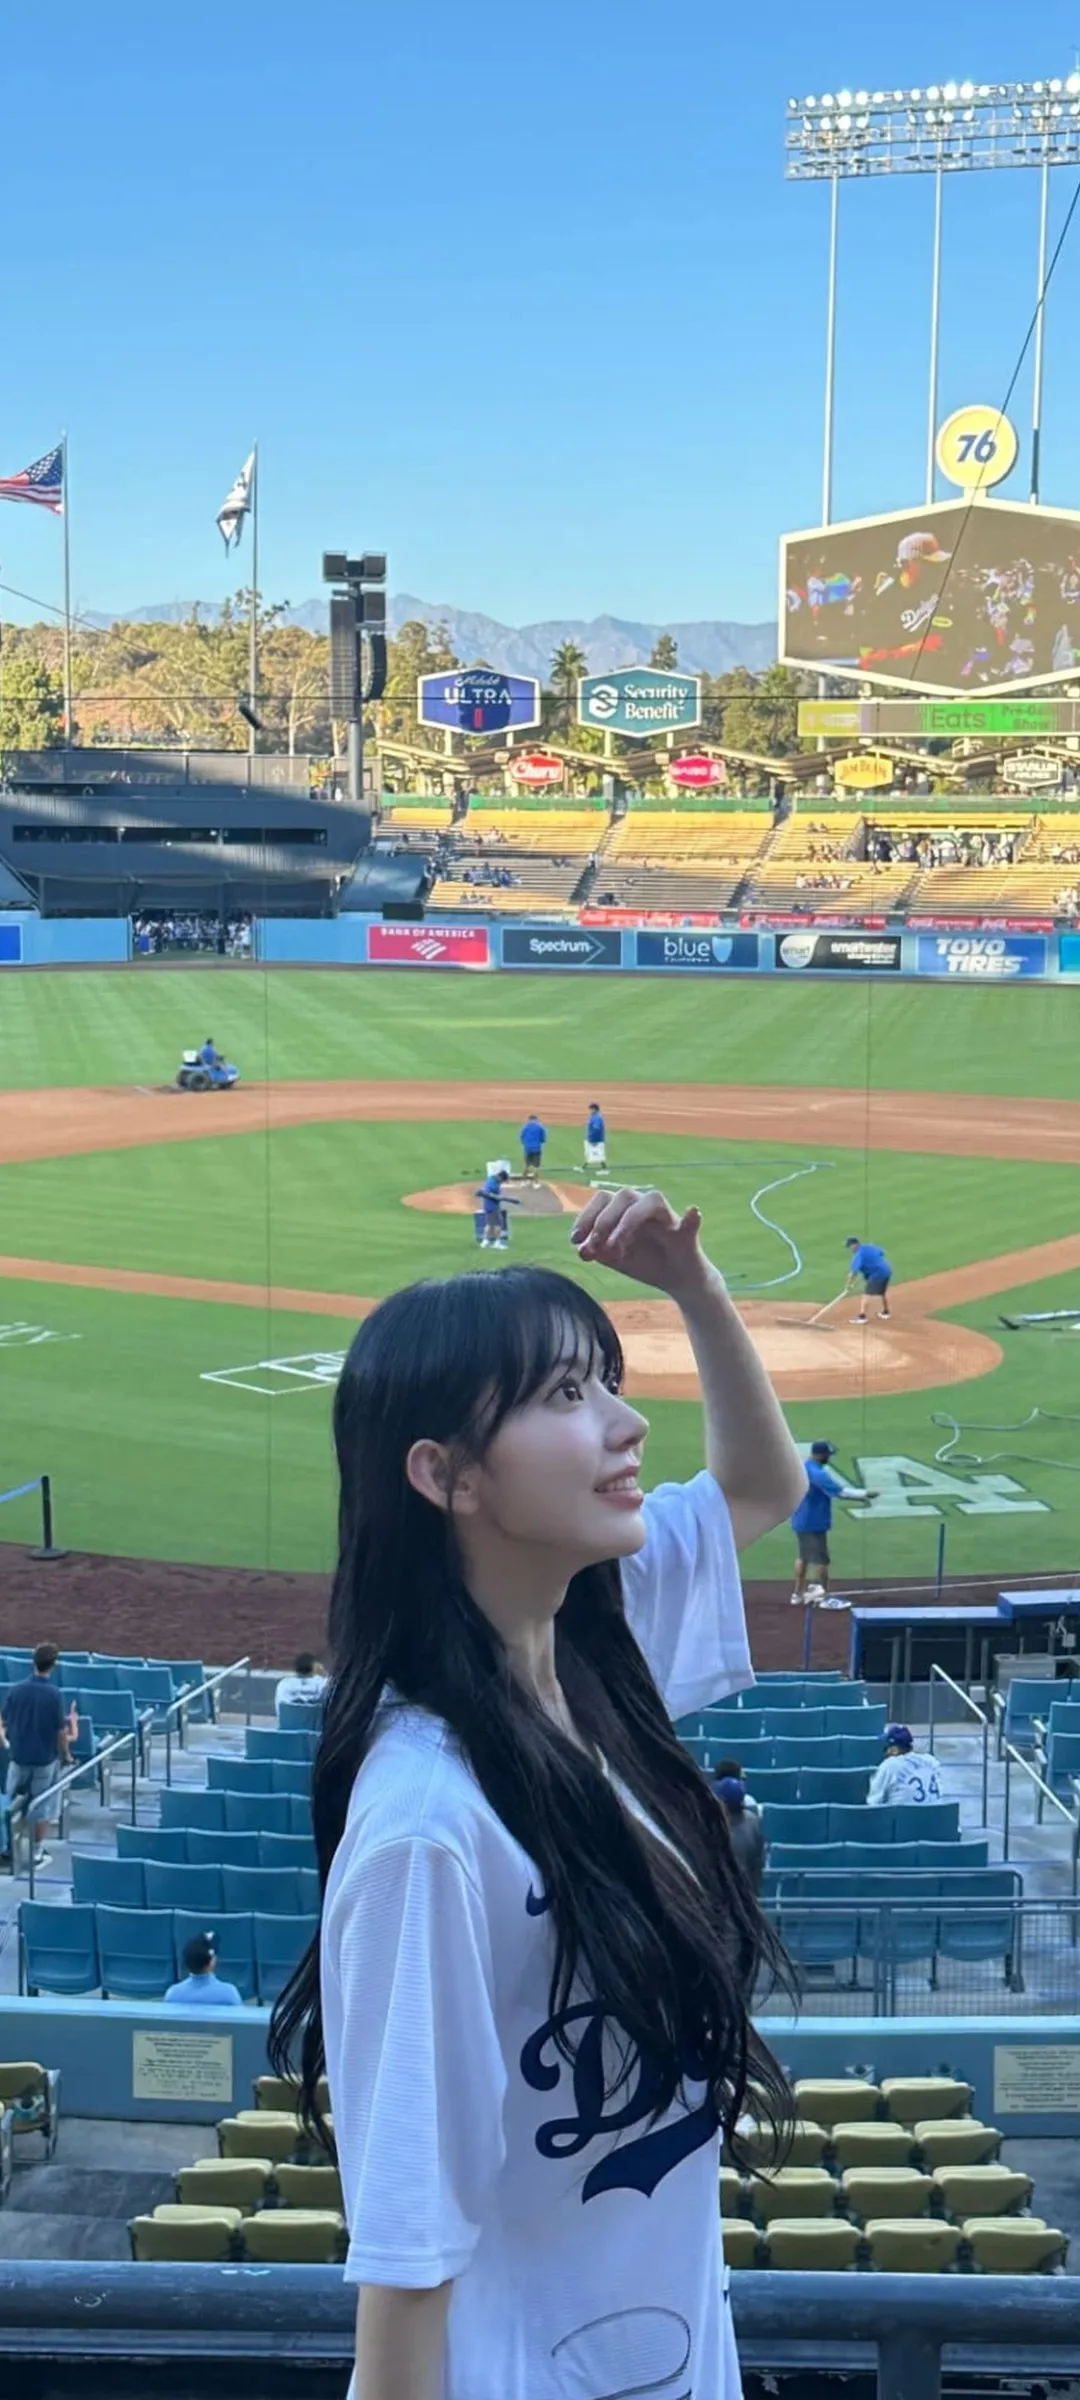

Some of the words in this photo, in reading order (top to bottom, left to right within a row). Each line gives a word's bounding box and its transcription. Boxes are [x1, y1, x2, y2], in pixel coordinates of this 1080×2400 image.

[956, 429, 997, 463] 76
[444, 687, 512, 705] ULTRA
[623, 683, 688, 703] Security
[624, 700, 679, 719] Benefit
[931, 708, 986, 729] Eats
[380, 927, 410, 937] BANK
[412, 927, 425, 937] OF
[427, 928, 476, 938] AMERICA
[529, 938, 591, 955] Spectrum
[664, 936, 711, 956] blue
[936, 938, 1006, 955] TOYO
[946, 955, 1023, 973] TIRES
[908, 1774, 940, 1803] 34
